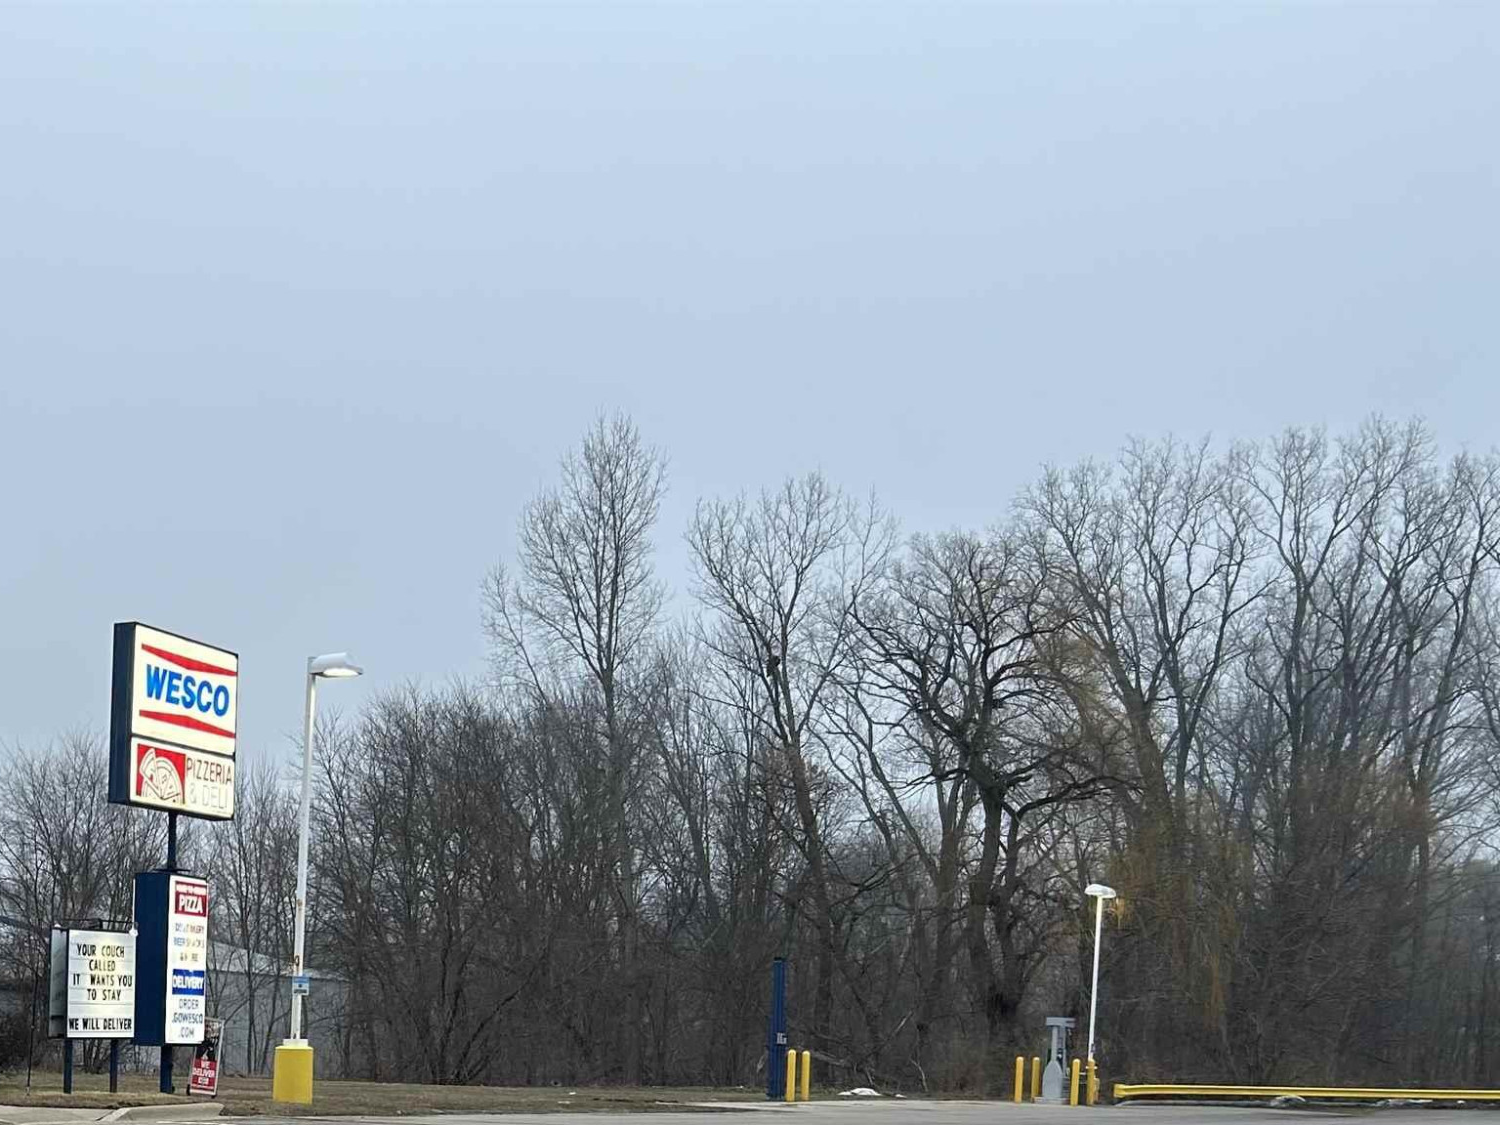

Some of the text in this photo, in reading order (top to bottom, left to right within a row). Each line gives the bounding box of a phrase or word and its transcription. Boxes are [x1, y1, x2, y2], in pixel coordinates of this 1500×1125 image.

[146, 664, 230, 717] WESCO
[186, 757, 232, 785] PIZZERIA
[202, 785, 228, 810] DELI
[179, 893, 204, 914] PIZZA
[77, 943, 125, 958] YOUR COUCH
[89, 959, 116, 972] CALLED
[73, 973, 132, 988] IT WANTS YOU
[172, 975, 204, 990] DELIVERY
[87, 988, 122, 1001] TO STAY
[179, 998, 199, 1010] ORDER
[68, 1018, 132, 1030] WE WILL DELIVER
